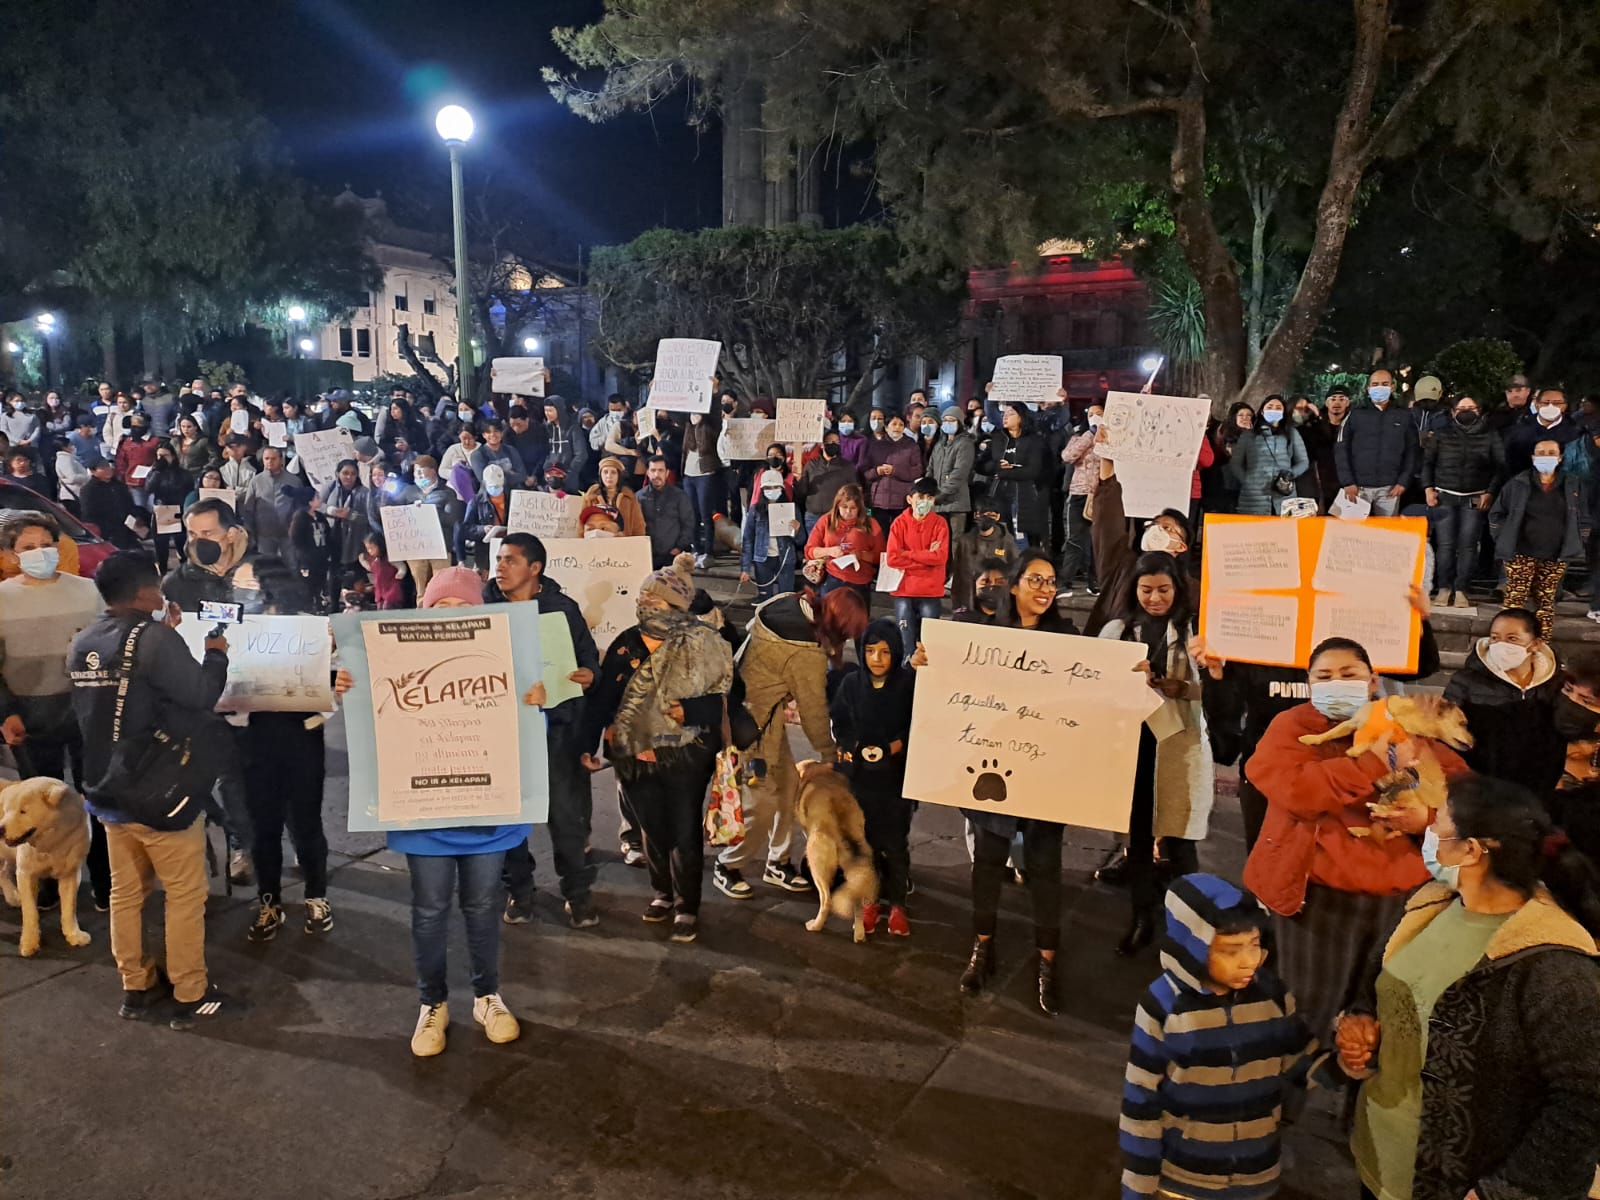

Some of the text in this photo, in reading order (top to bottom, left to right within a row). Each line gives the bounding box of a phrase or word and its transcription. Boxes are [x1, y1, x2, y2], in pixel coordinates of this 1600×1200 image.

[401, 631, 470, 640] MATAN PERROS
[947, 692, 1080, 728] aquellos que no
